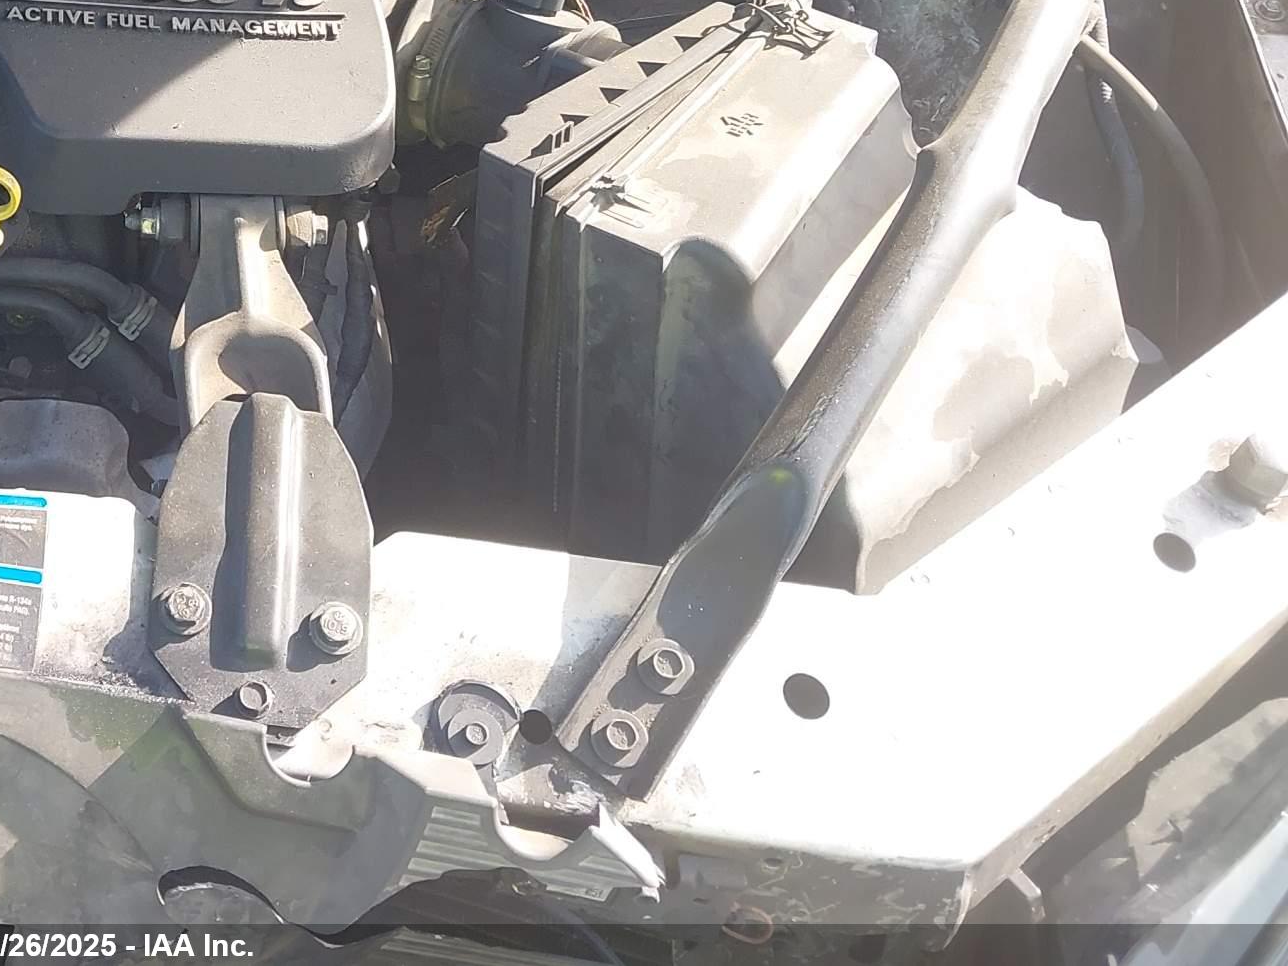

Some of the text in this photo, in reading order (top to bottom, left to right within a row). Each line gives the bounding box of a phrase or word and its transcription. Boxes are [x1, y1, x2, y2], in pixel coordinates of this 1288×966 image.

[6, 6, 343, 38] ACTIVE FUEL MANAGEMENT
